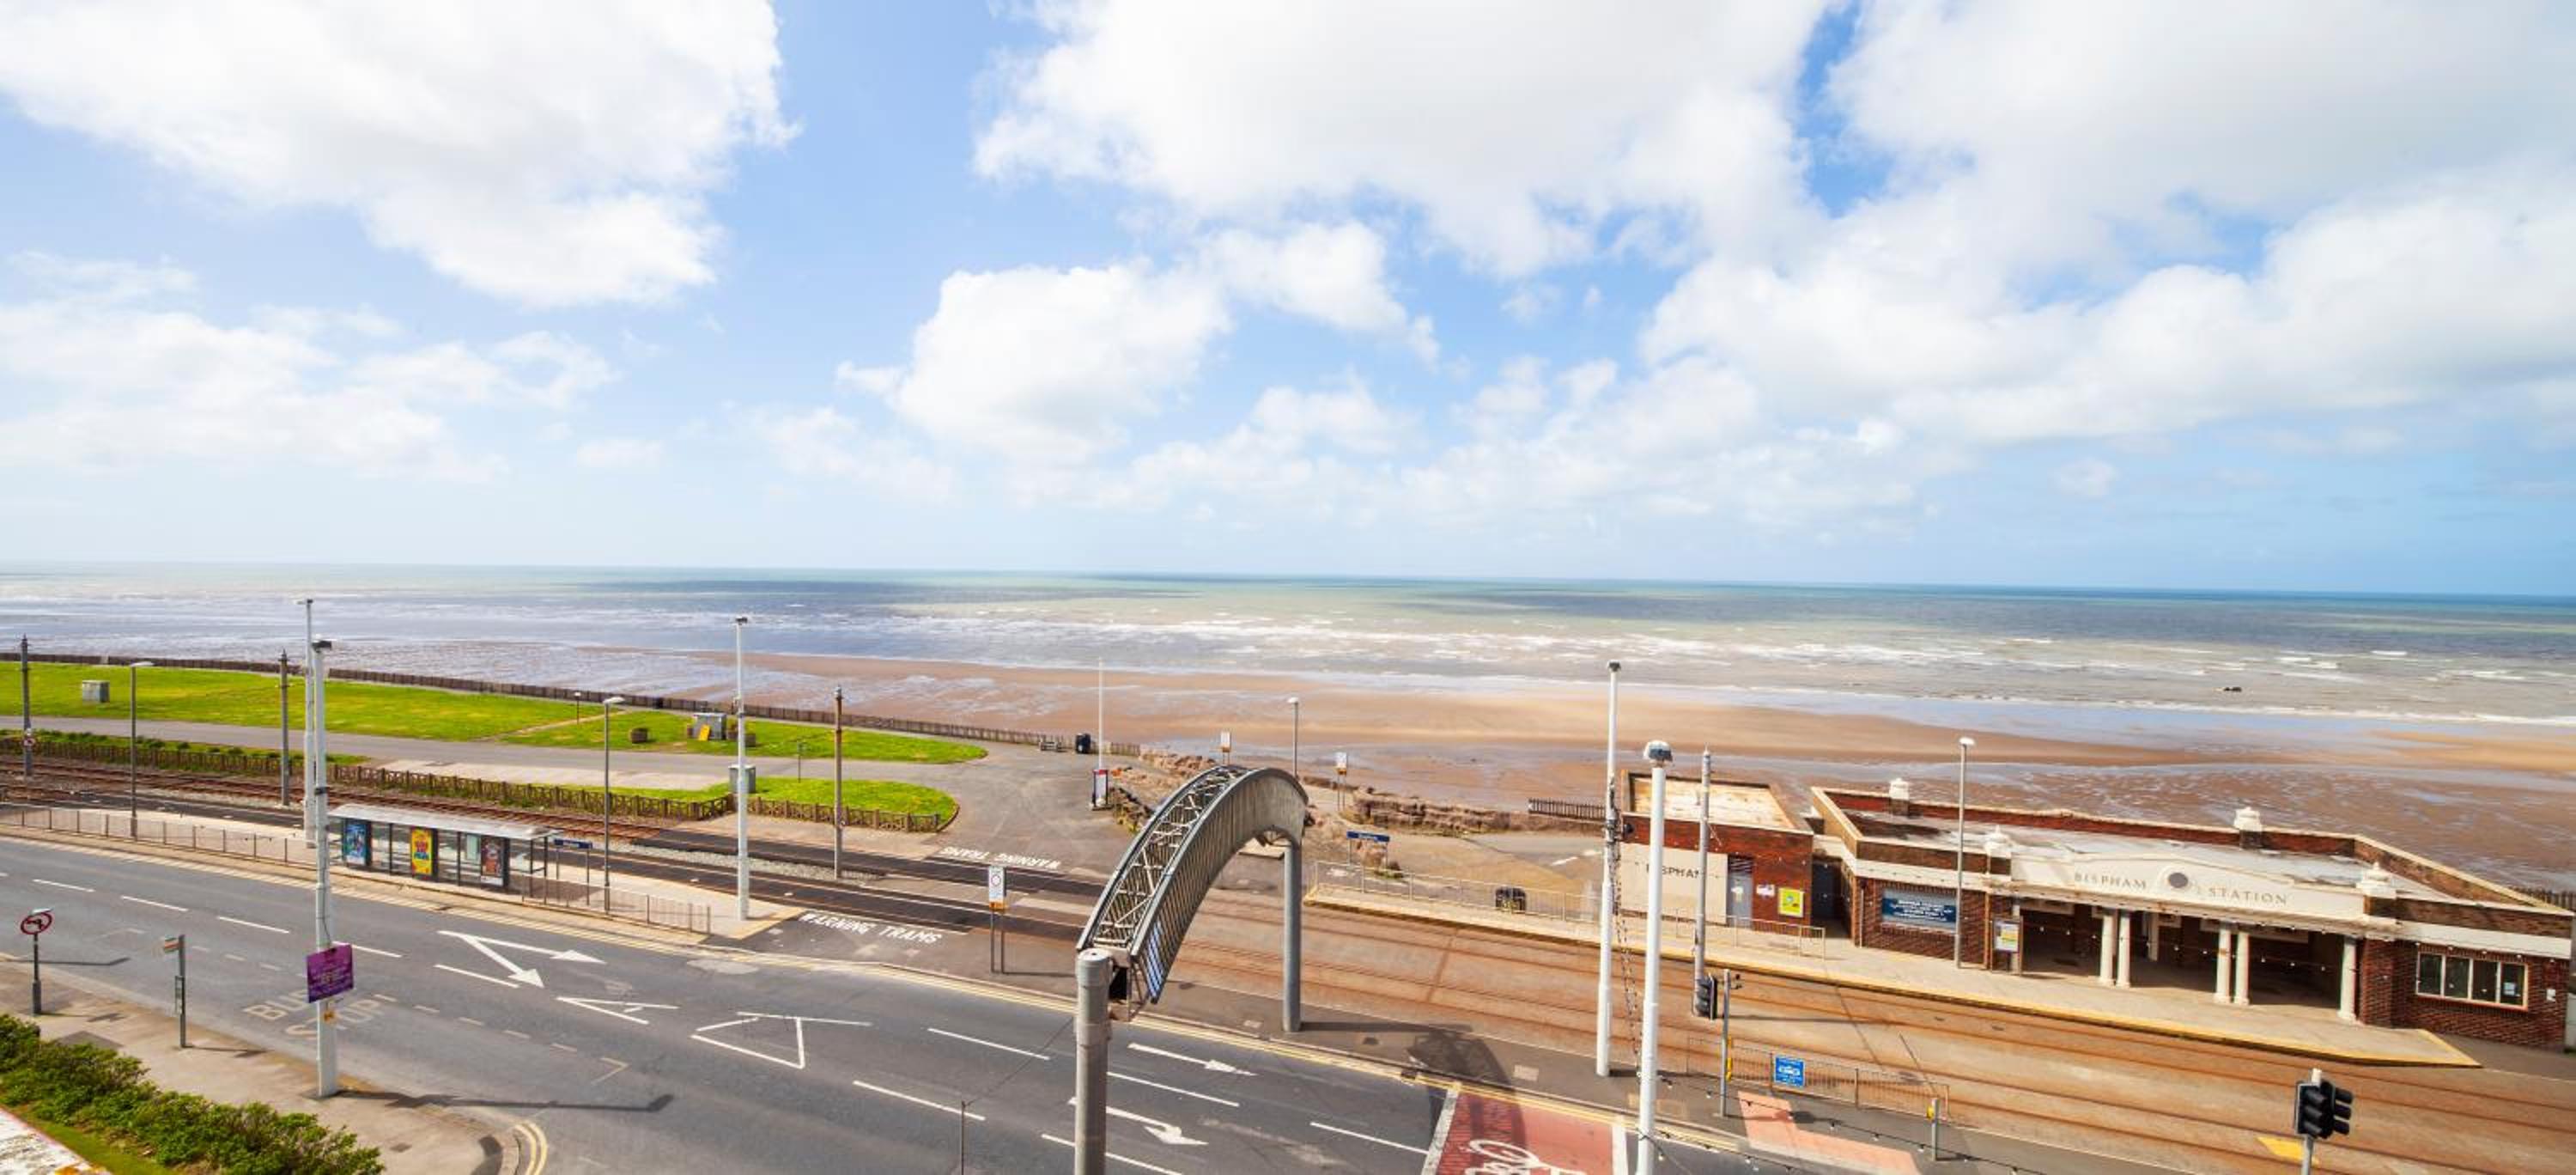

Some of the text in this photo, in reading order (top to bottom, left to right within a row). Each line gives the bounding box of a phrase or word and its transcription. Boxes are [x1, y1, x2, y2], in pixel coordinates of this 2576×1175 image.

[2075, 872, 2287, 905] BISPHAM STATION
[798, 912, 943, 944] WARNING TRAMS
